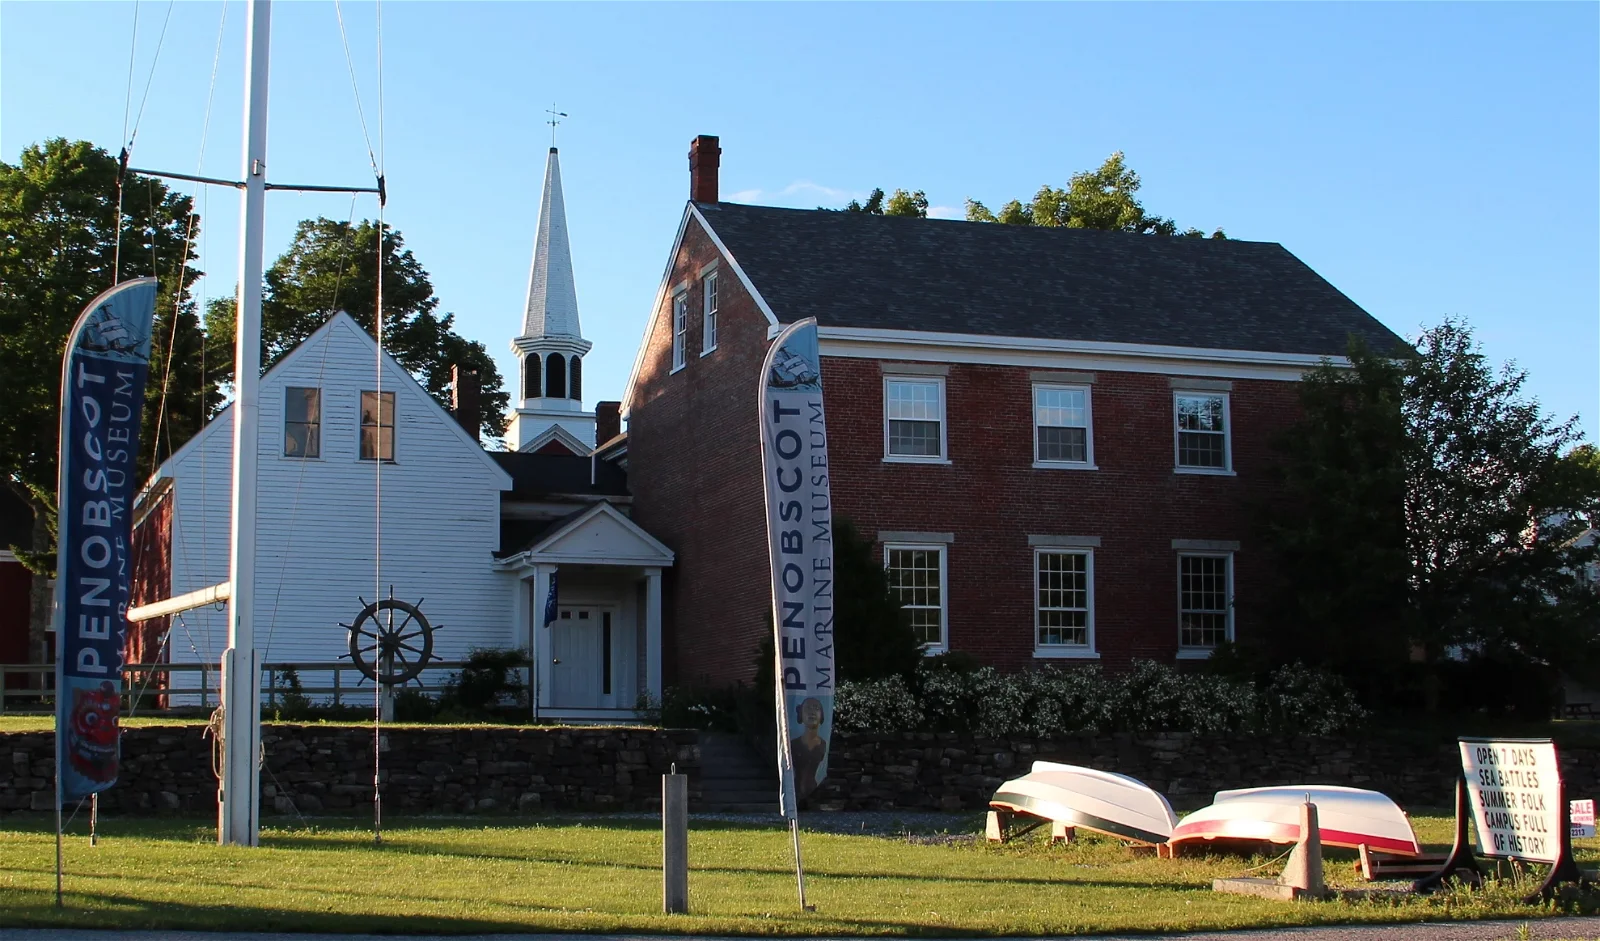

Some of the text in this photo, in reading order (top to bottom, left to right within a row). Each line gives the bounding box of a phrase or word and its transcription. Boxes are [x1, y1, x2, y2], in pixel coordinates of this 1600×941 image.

[106, 370, 135, 521] MUSEUM
[77, 362, 111, 673] PENOBSCOT
[773, 399, 807, 690] PENOBSCOT
[808, 400, 834, 690] MARINE MUSEUM
[1476, 747, 1536, 766] OPEN 7 DAYS
[1479, 769, 1539, 788] SEA BATTLES
[1479, 790, 1547, 811] SUMMER FOLK
[1484, 811, 1548, 833] CAMPUS FULL
[1494, 833, 1546, 854] OF HISTORY
